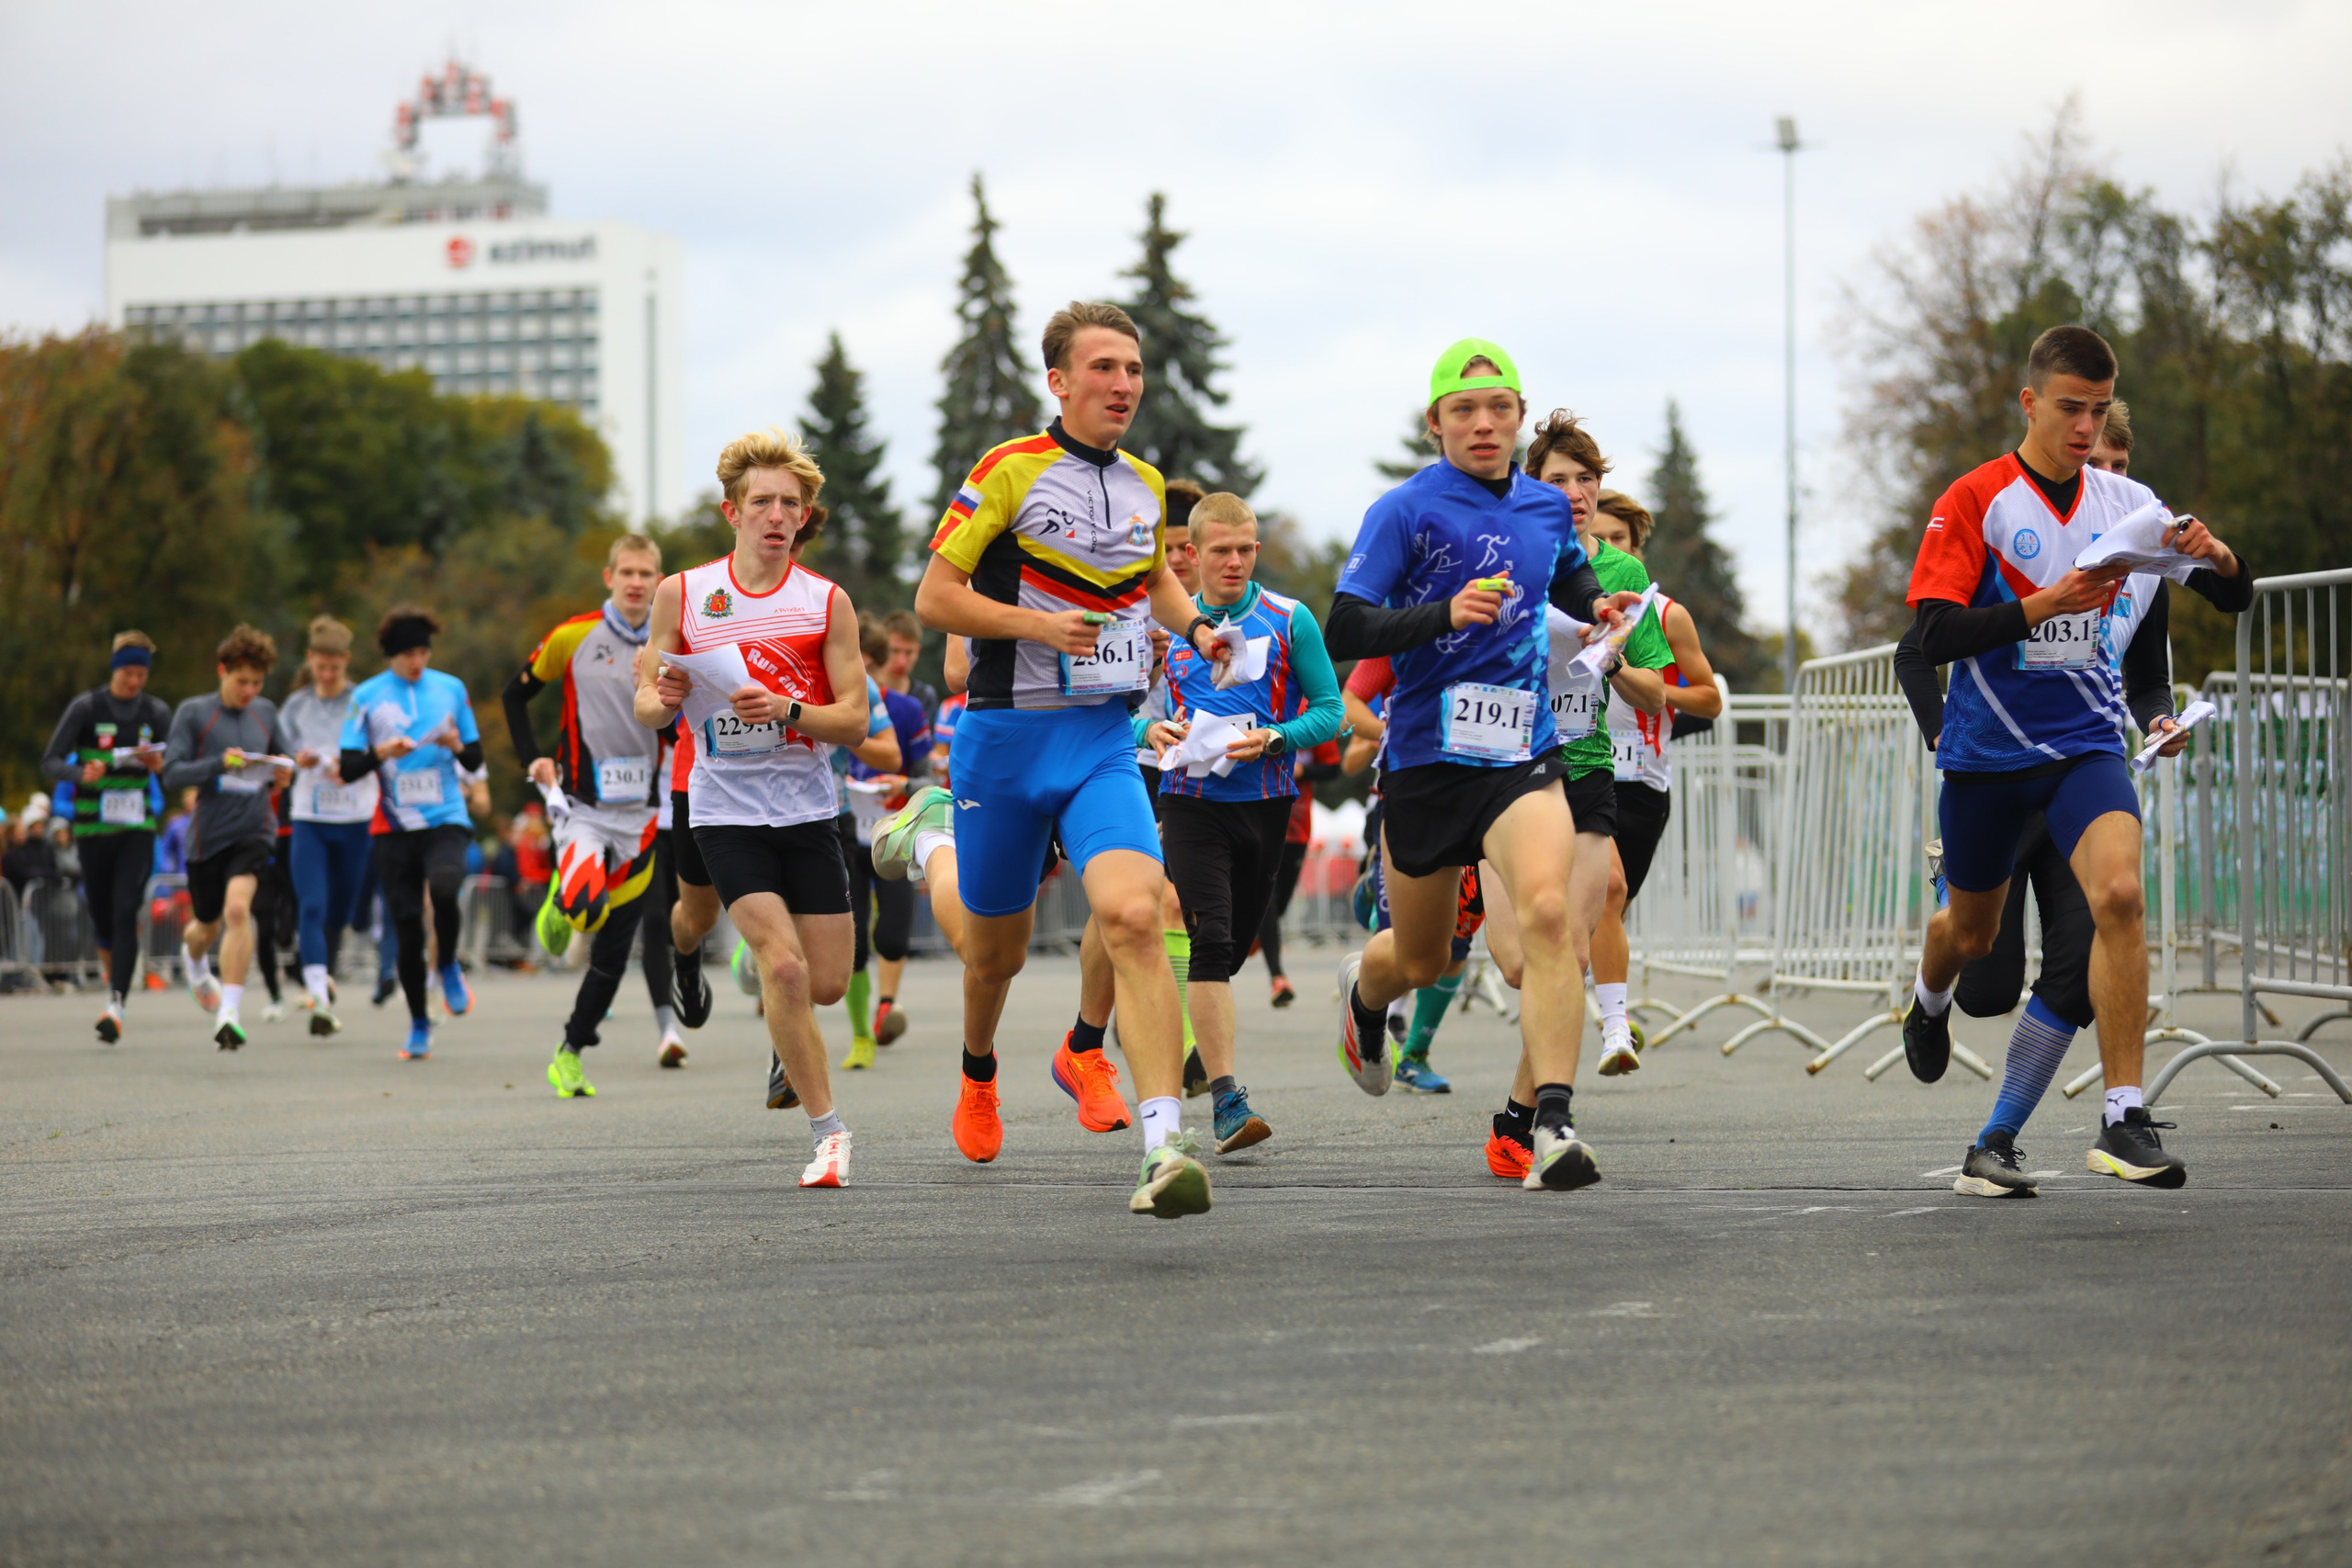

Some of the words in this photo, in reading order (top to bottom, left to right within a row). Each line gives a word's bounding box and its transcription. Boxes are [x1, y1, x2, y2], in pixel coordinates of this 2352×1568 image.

[2028, 619, 2090, 643] 203.1
[746, 648, 779, 675] Run
[778, 674, 807, 700] and
[1454, 698, 1520, 729] 219.1
[604, 769, 645, 784] 230.1
